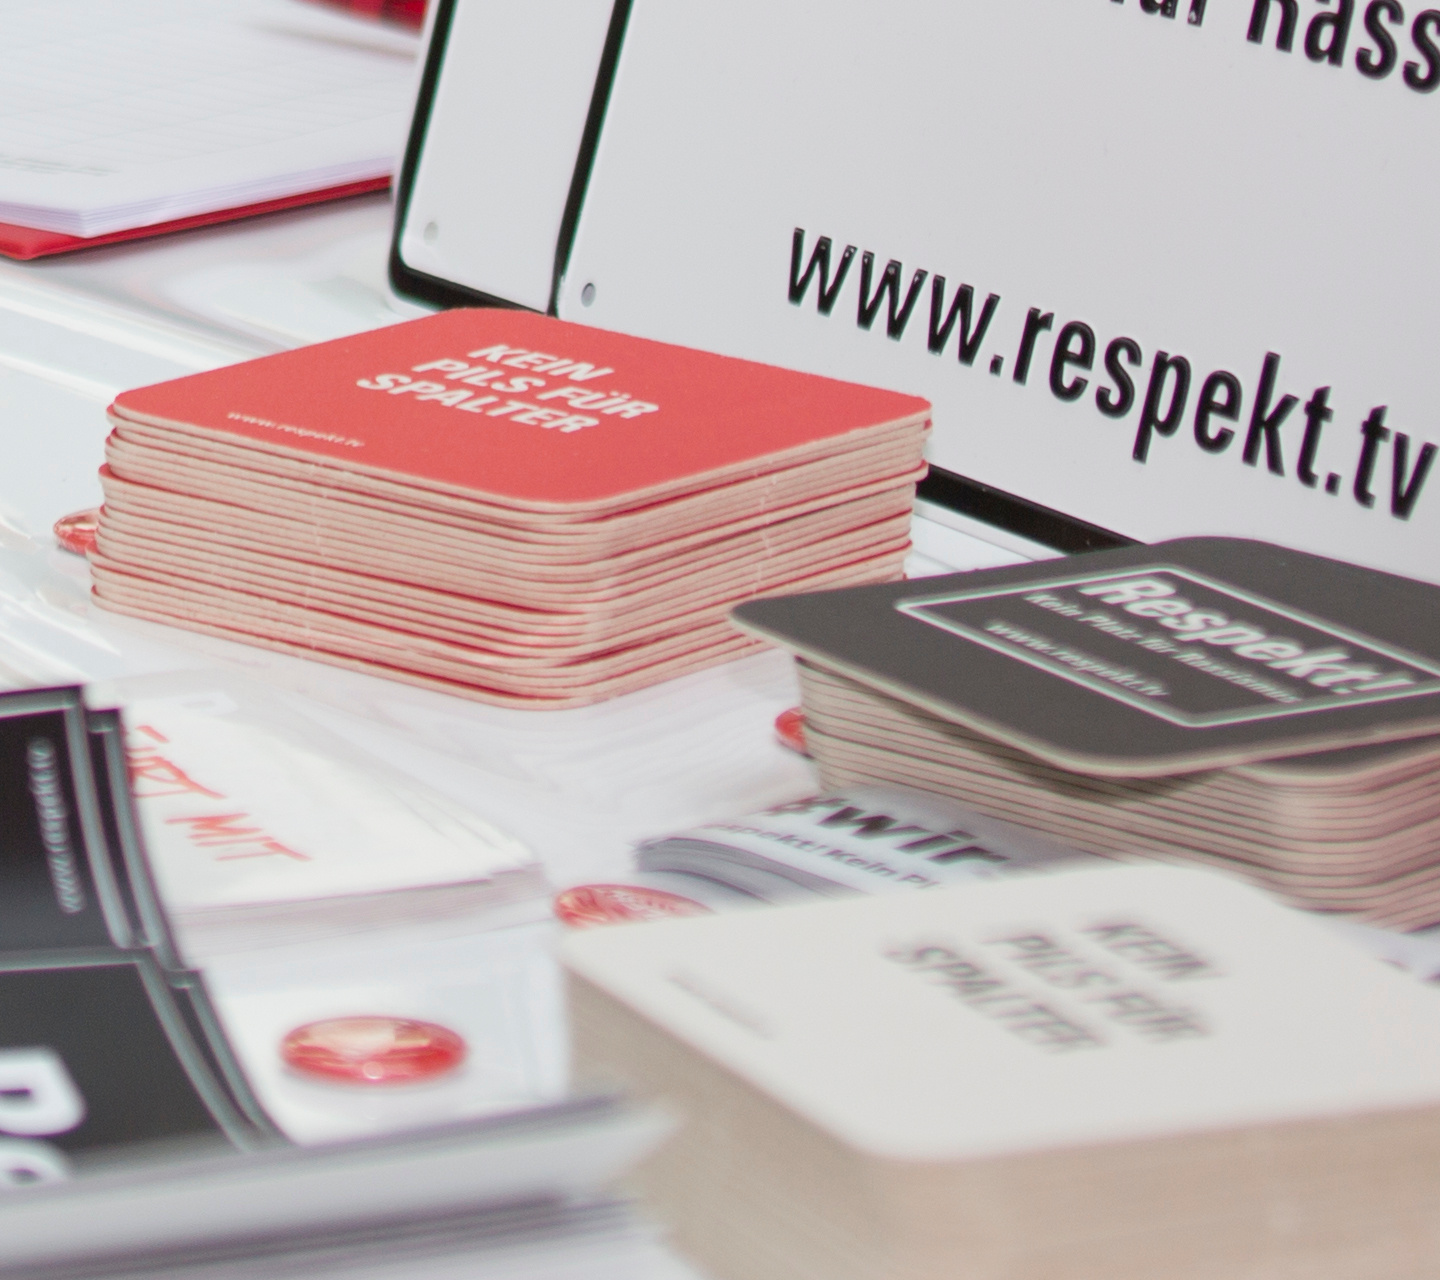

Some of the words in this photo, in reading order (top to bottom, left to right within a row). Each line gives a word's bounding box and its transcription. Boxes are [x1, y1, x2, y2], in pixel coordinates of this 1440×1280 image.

[411, 357, 546, 394] PILS
[536, 387, 660, 420] FÜR
[466, 343, 615, 382] KEIN
[787, 226, 1440, 522] www.respekt.tv
[356, 372, 601, 434] SPALTER
[1078, 576, 1417, 695] Respekt!
